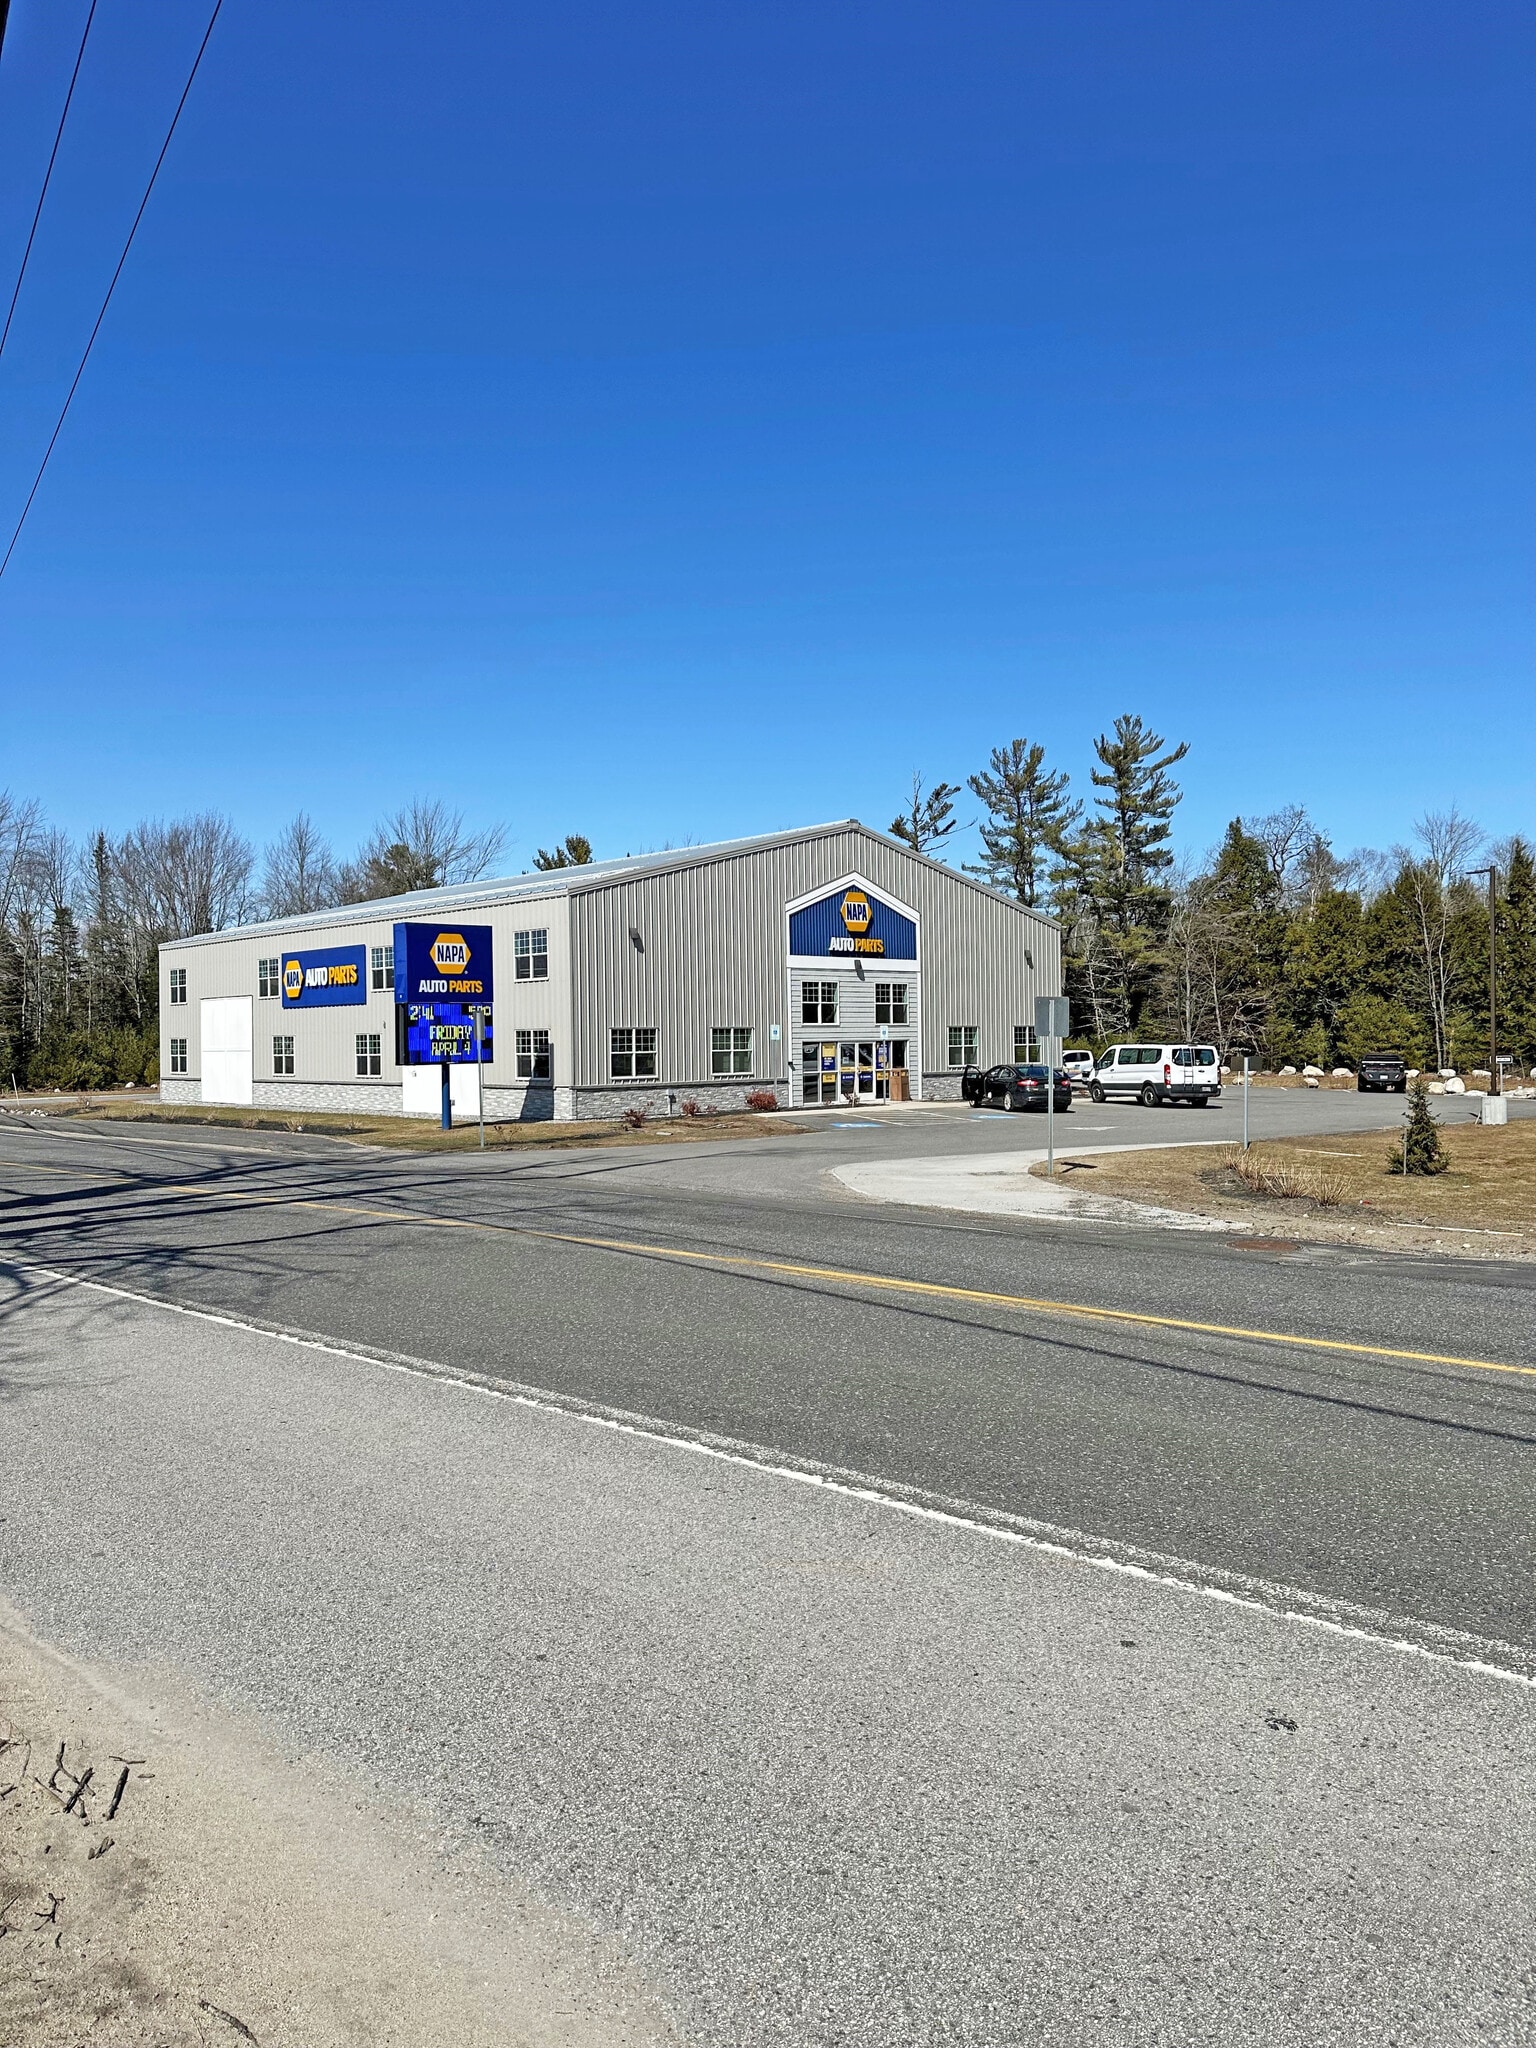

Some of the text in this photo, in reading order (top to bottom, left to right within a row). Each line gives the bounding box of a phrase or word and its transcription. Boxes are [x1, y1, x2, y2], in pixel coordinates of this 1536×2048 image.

[846, 903, 868, 922] NAPA
[829, 937, 884, 953] AUTO PARTS
[437, 944, 465, 963] NAPA
[286, 964, 357, 988] NAPA AUTO PARTS
[418, 979, 483, 993] AUTO PARTS
[409, 1005, 435, 1020] 2:41
[429, 1025, 473, 1040] FRIDAY
